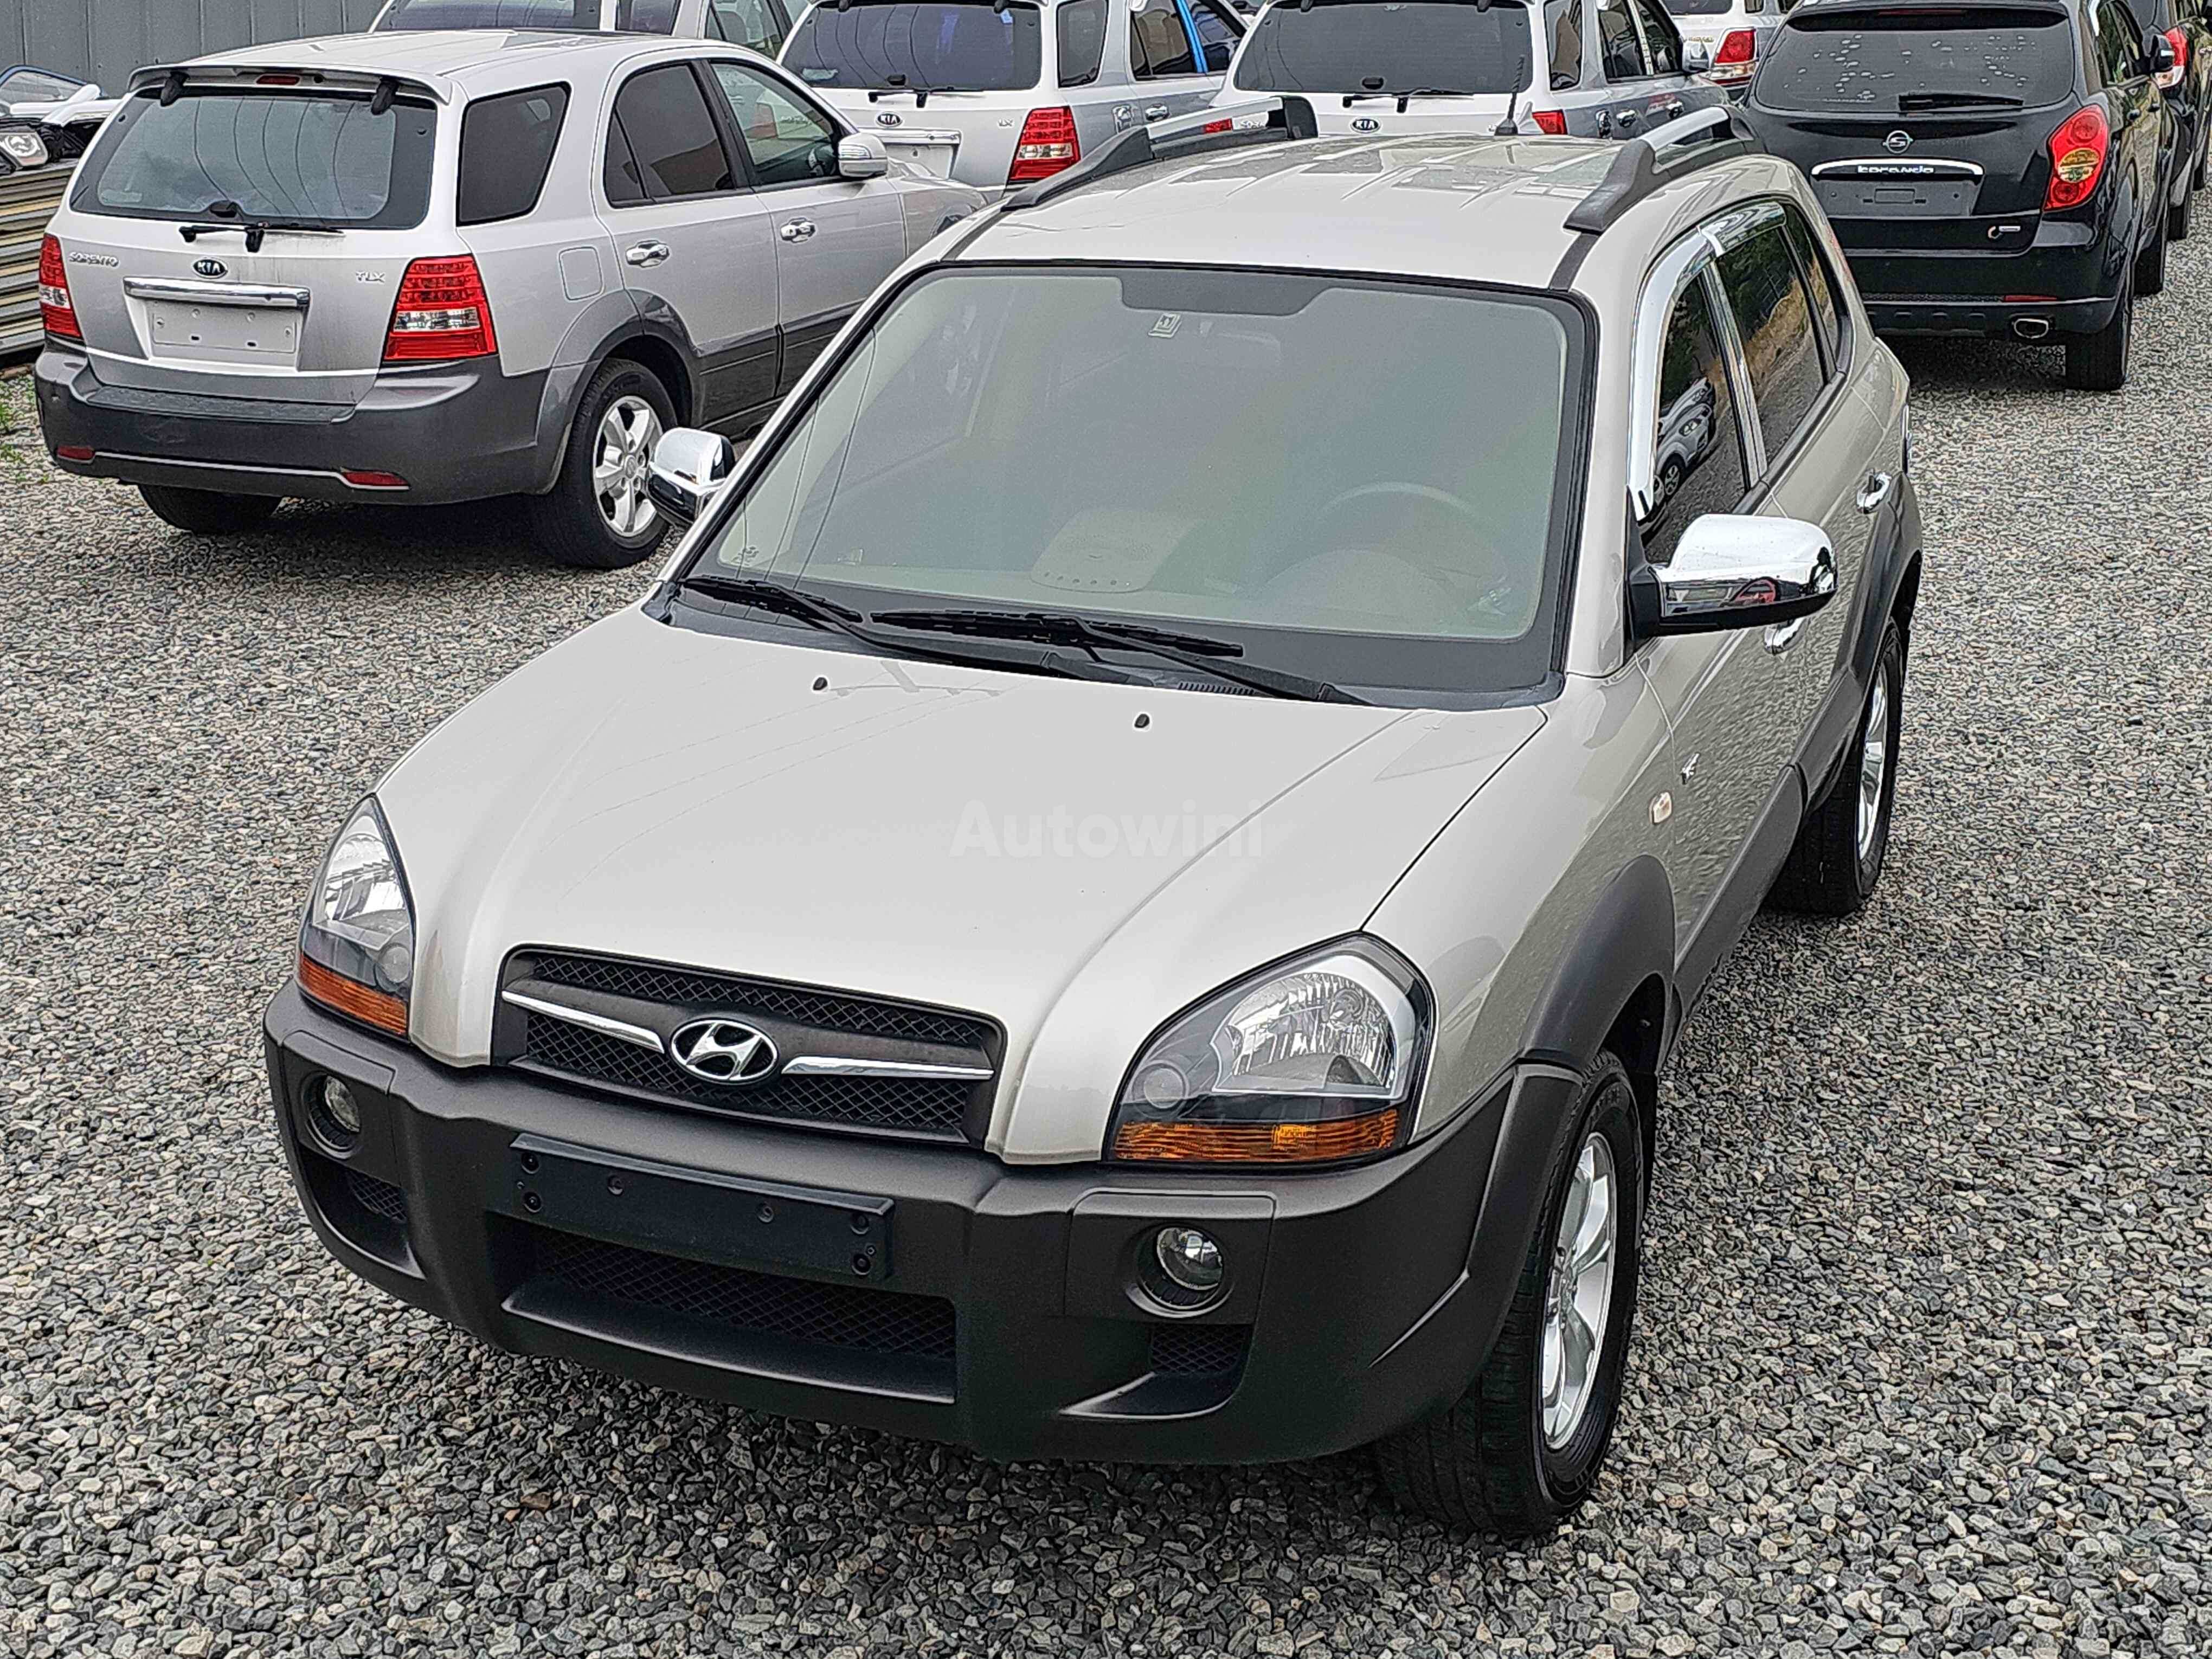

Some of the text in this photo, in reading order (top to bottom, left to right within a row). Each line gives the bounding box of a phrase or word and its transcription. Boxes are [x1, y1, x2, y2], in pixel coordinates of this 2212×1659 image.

[880, 115, 898, 124] KIA
[1356, 120, 1375, 129] KIA
[197, 261, 221, 273] KIA
[356, 271, 385, 285] TLX
